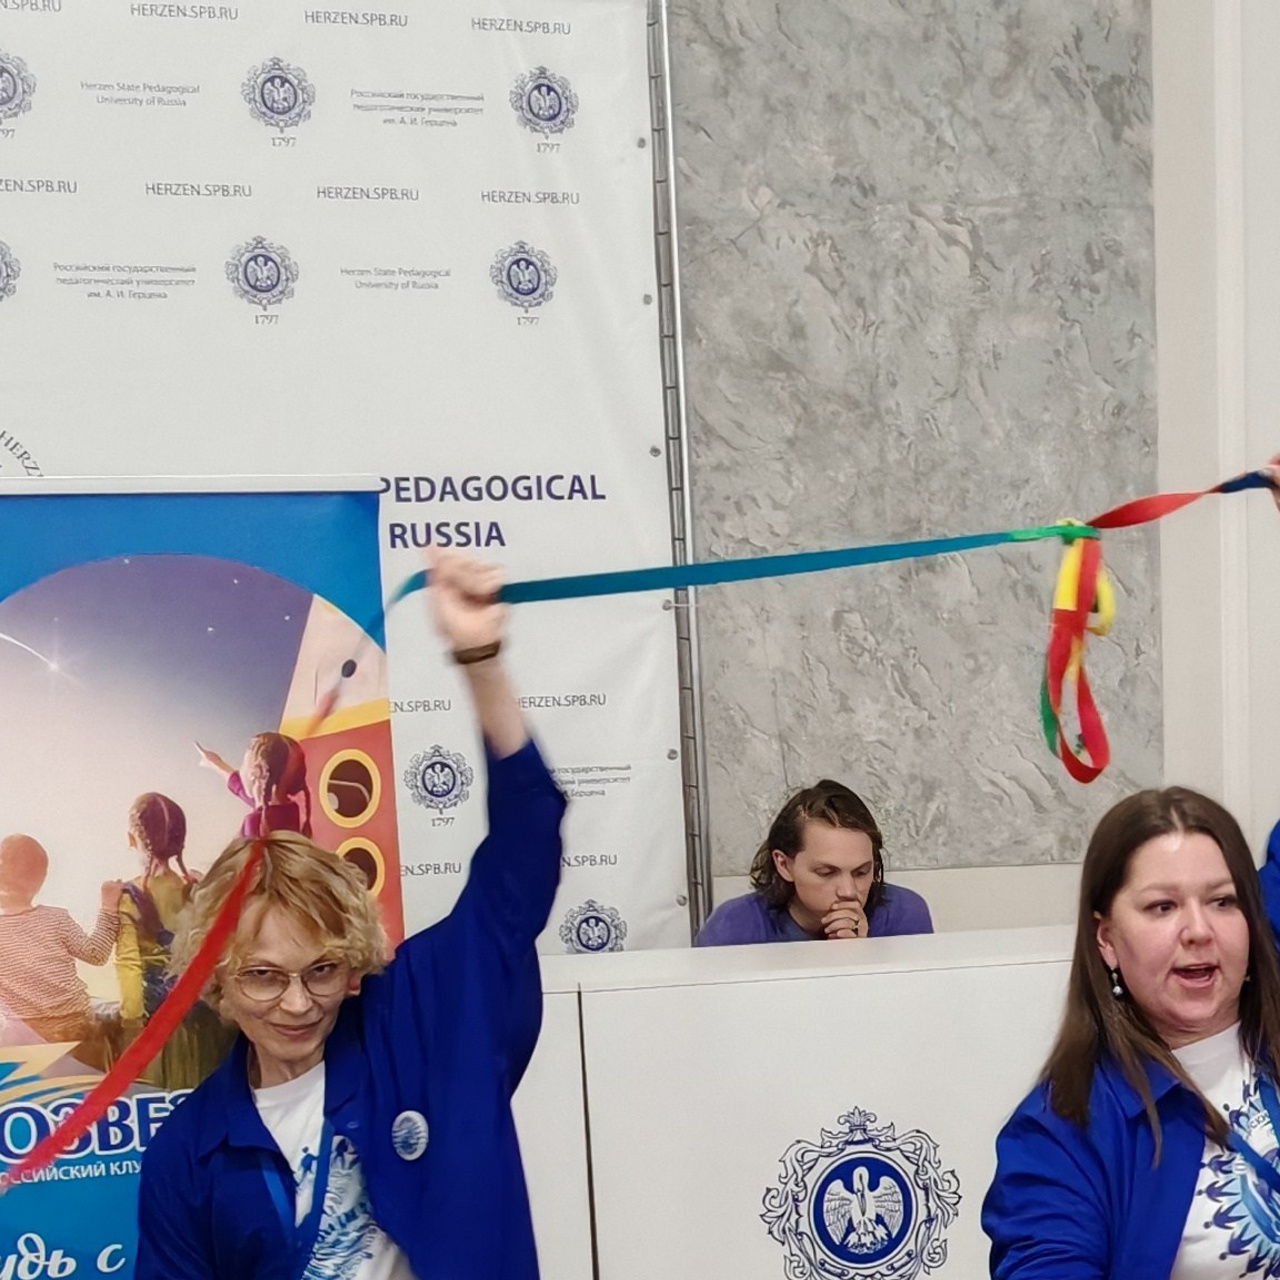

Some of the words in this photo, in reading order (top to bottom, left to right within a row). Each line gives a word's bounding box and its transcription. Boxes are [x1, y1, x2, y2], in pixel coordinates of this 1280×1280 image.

[130, 3, 238, 21] HERZEN.SPB.RU
[304, 10, 408, 27] HERZEN.SPB.RU
[471, 17, 571, 35] HERZEN.SPB.RU
[271, 136, 298, 148] 1797
[535, 142, 562, 154] 1797
[145, 182, 252, 198] HERZEN.SPB.RU
[316, 186, 419, 202] HERZEN.SPB.RU
[480, 189, 580, 205] HERZEN.SPB.RU
[254, 314, 280, 326] 1797
[516, 316, 540, 327] 1797
[388, 521, 506, 549] RUSSIA
[519, 693, 607, 709] ERZEN.SPB.RU
[431, 817, 456, 828] 1797
[96, 1243, 126, 1274] с
